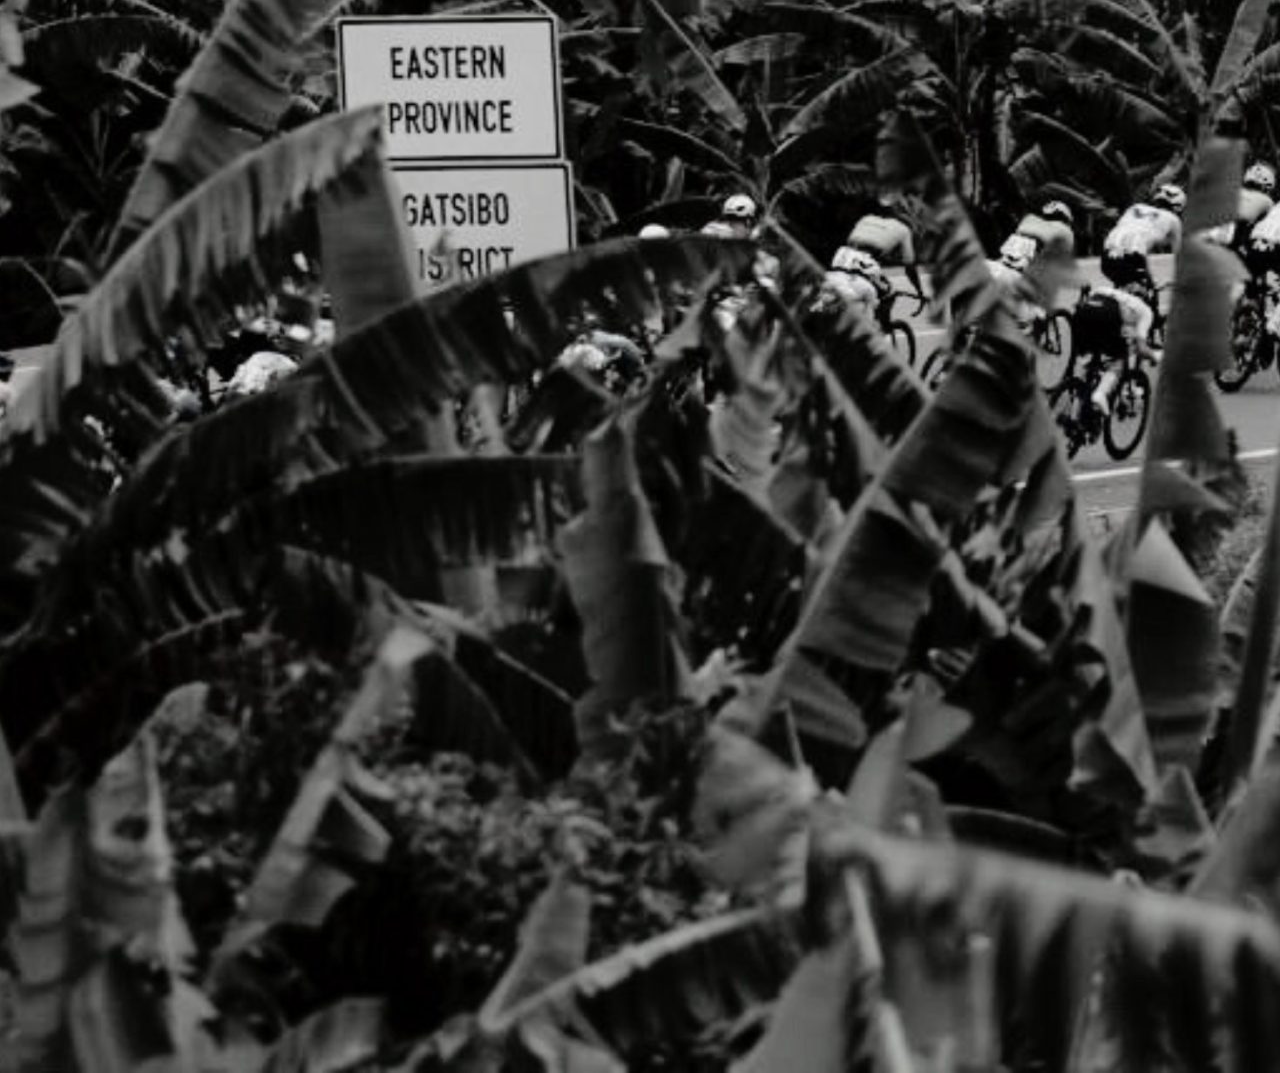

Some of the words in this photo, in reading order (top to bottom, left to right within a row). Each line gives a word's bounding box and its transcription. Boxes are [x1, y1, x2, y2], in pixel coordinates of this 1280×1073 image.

[390, 45, 506, 79] EASTERN
[388, 100, 514, 134] PROVINCE
[403, 192, 510, 226] GATSIBO
